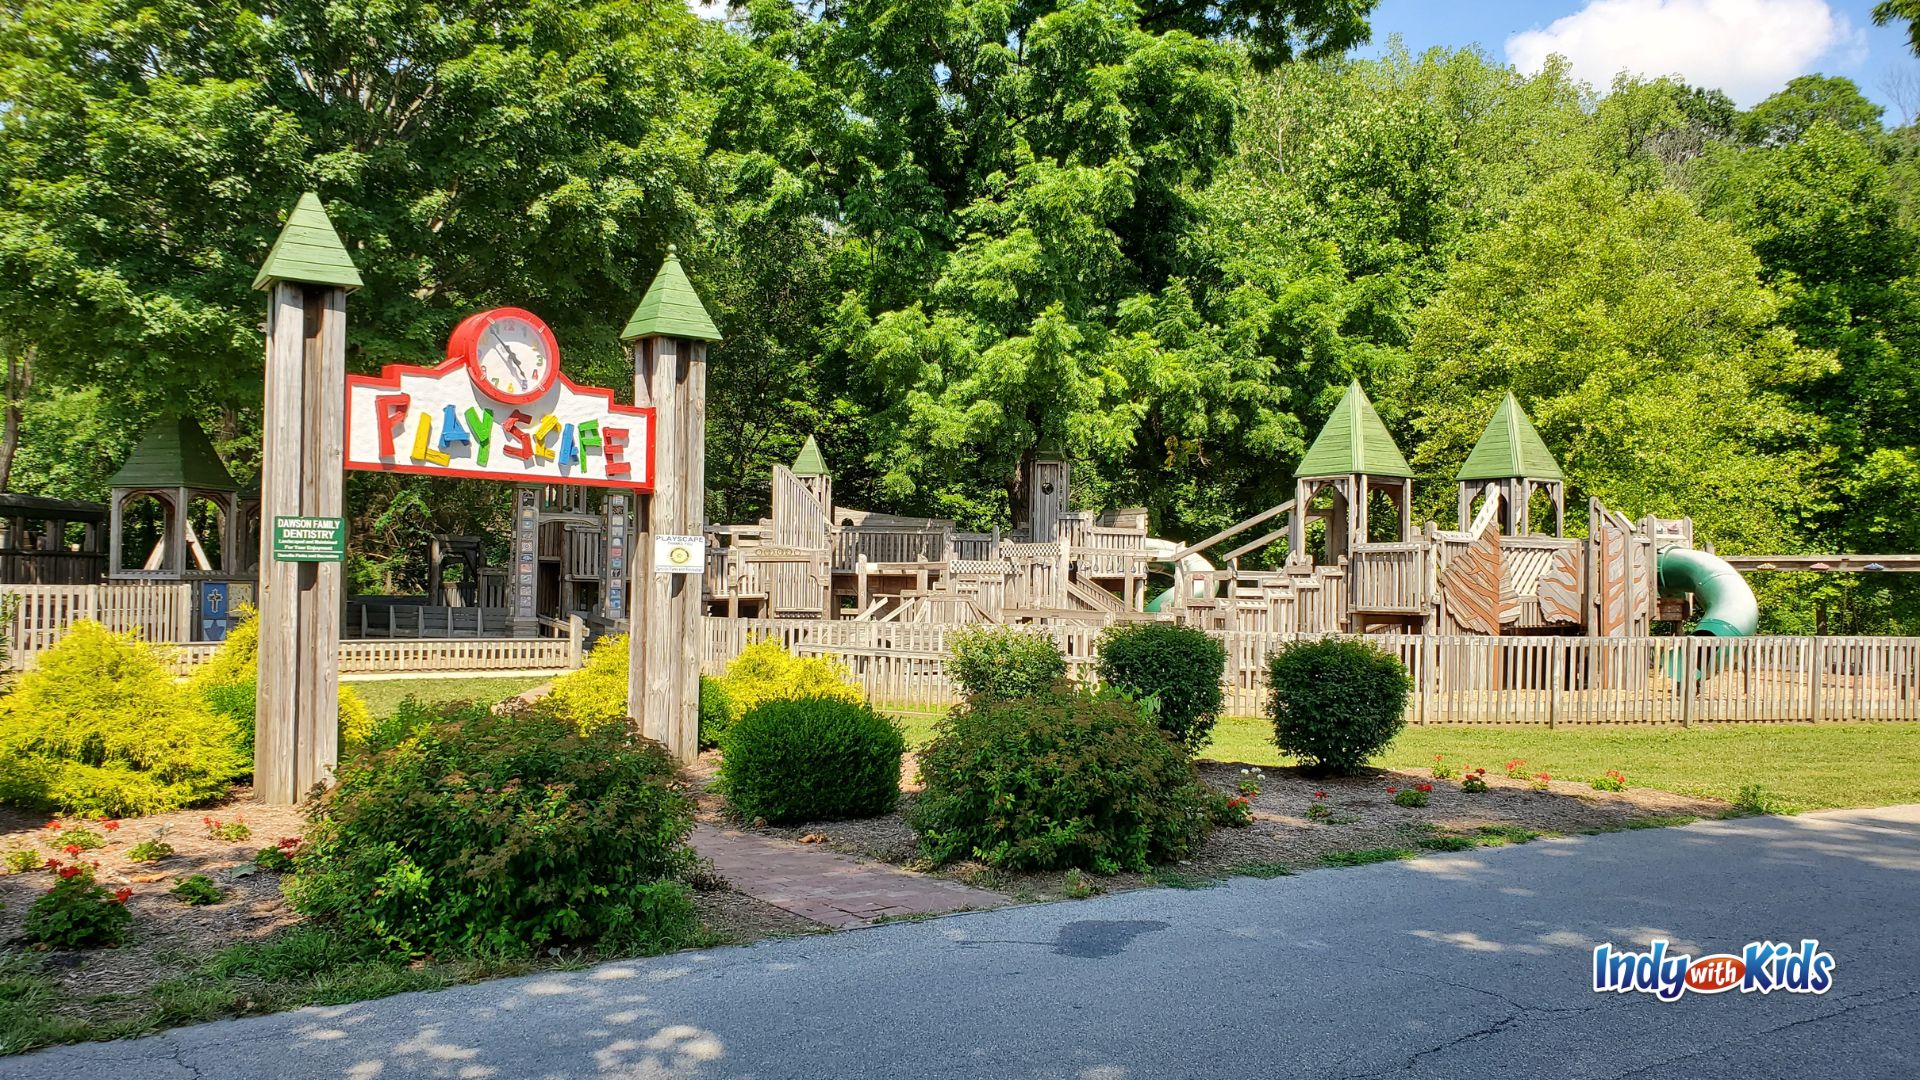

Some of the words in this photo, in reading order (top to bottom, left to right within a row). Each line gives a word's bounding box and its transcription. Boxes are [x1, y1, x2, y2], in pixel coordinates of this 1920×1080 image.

[536, 354, 545, 367] 3
[532, 368, 540, 380] 4
[374, 392, 632, 477] PLAYSCAPE
[278, 519, 311, 528] DAWSON
[313, 520, 340, 529] FAMILY
[284, 530, 335, 539] DENTISTRY
